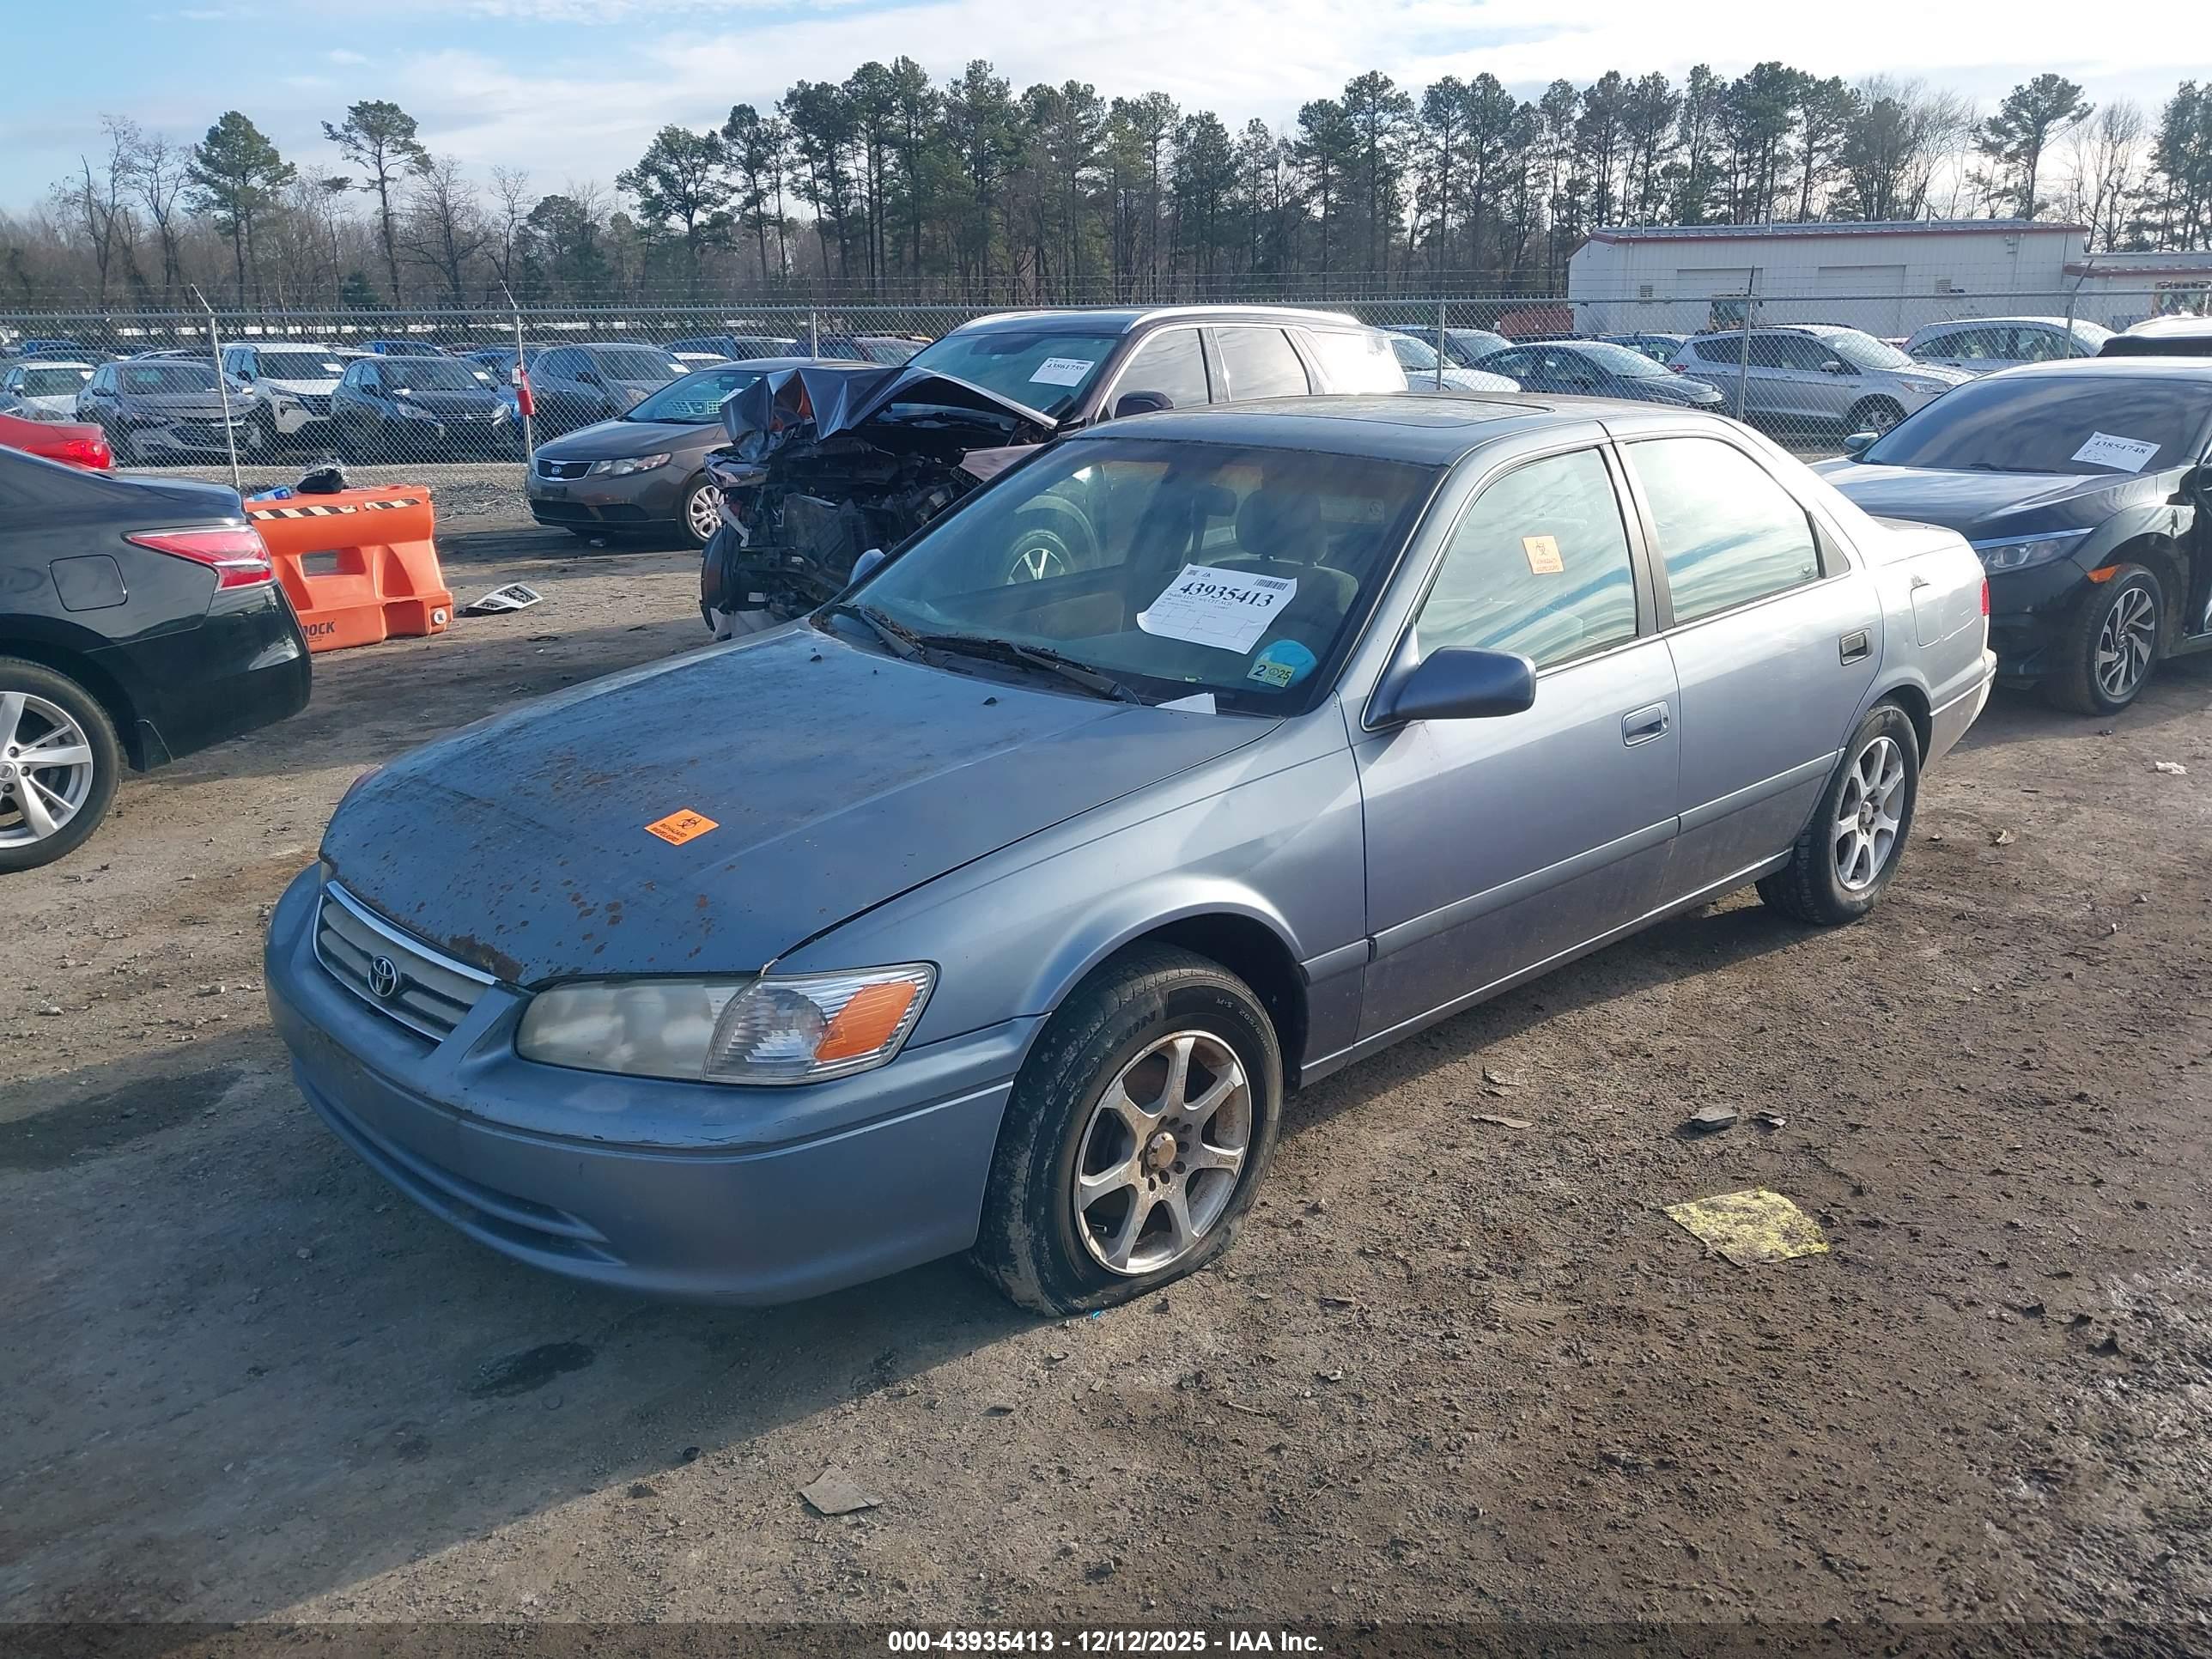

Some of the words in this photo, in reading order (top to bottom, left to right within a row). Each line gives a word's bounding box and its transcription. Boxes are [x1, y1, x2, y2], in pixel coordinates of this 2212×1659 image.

[2093, 440, 2148, 454] 43854748
[1179, 581, 1274, 608] 43935413
[1253, 665, 1267, 677] 2
[1277, 669, 1291, 680] 25
